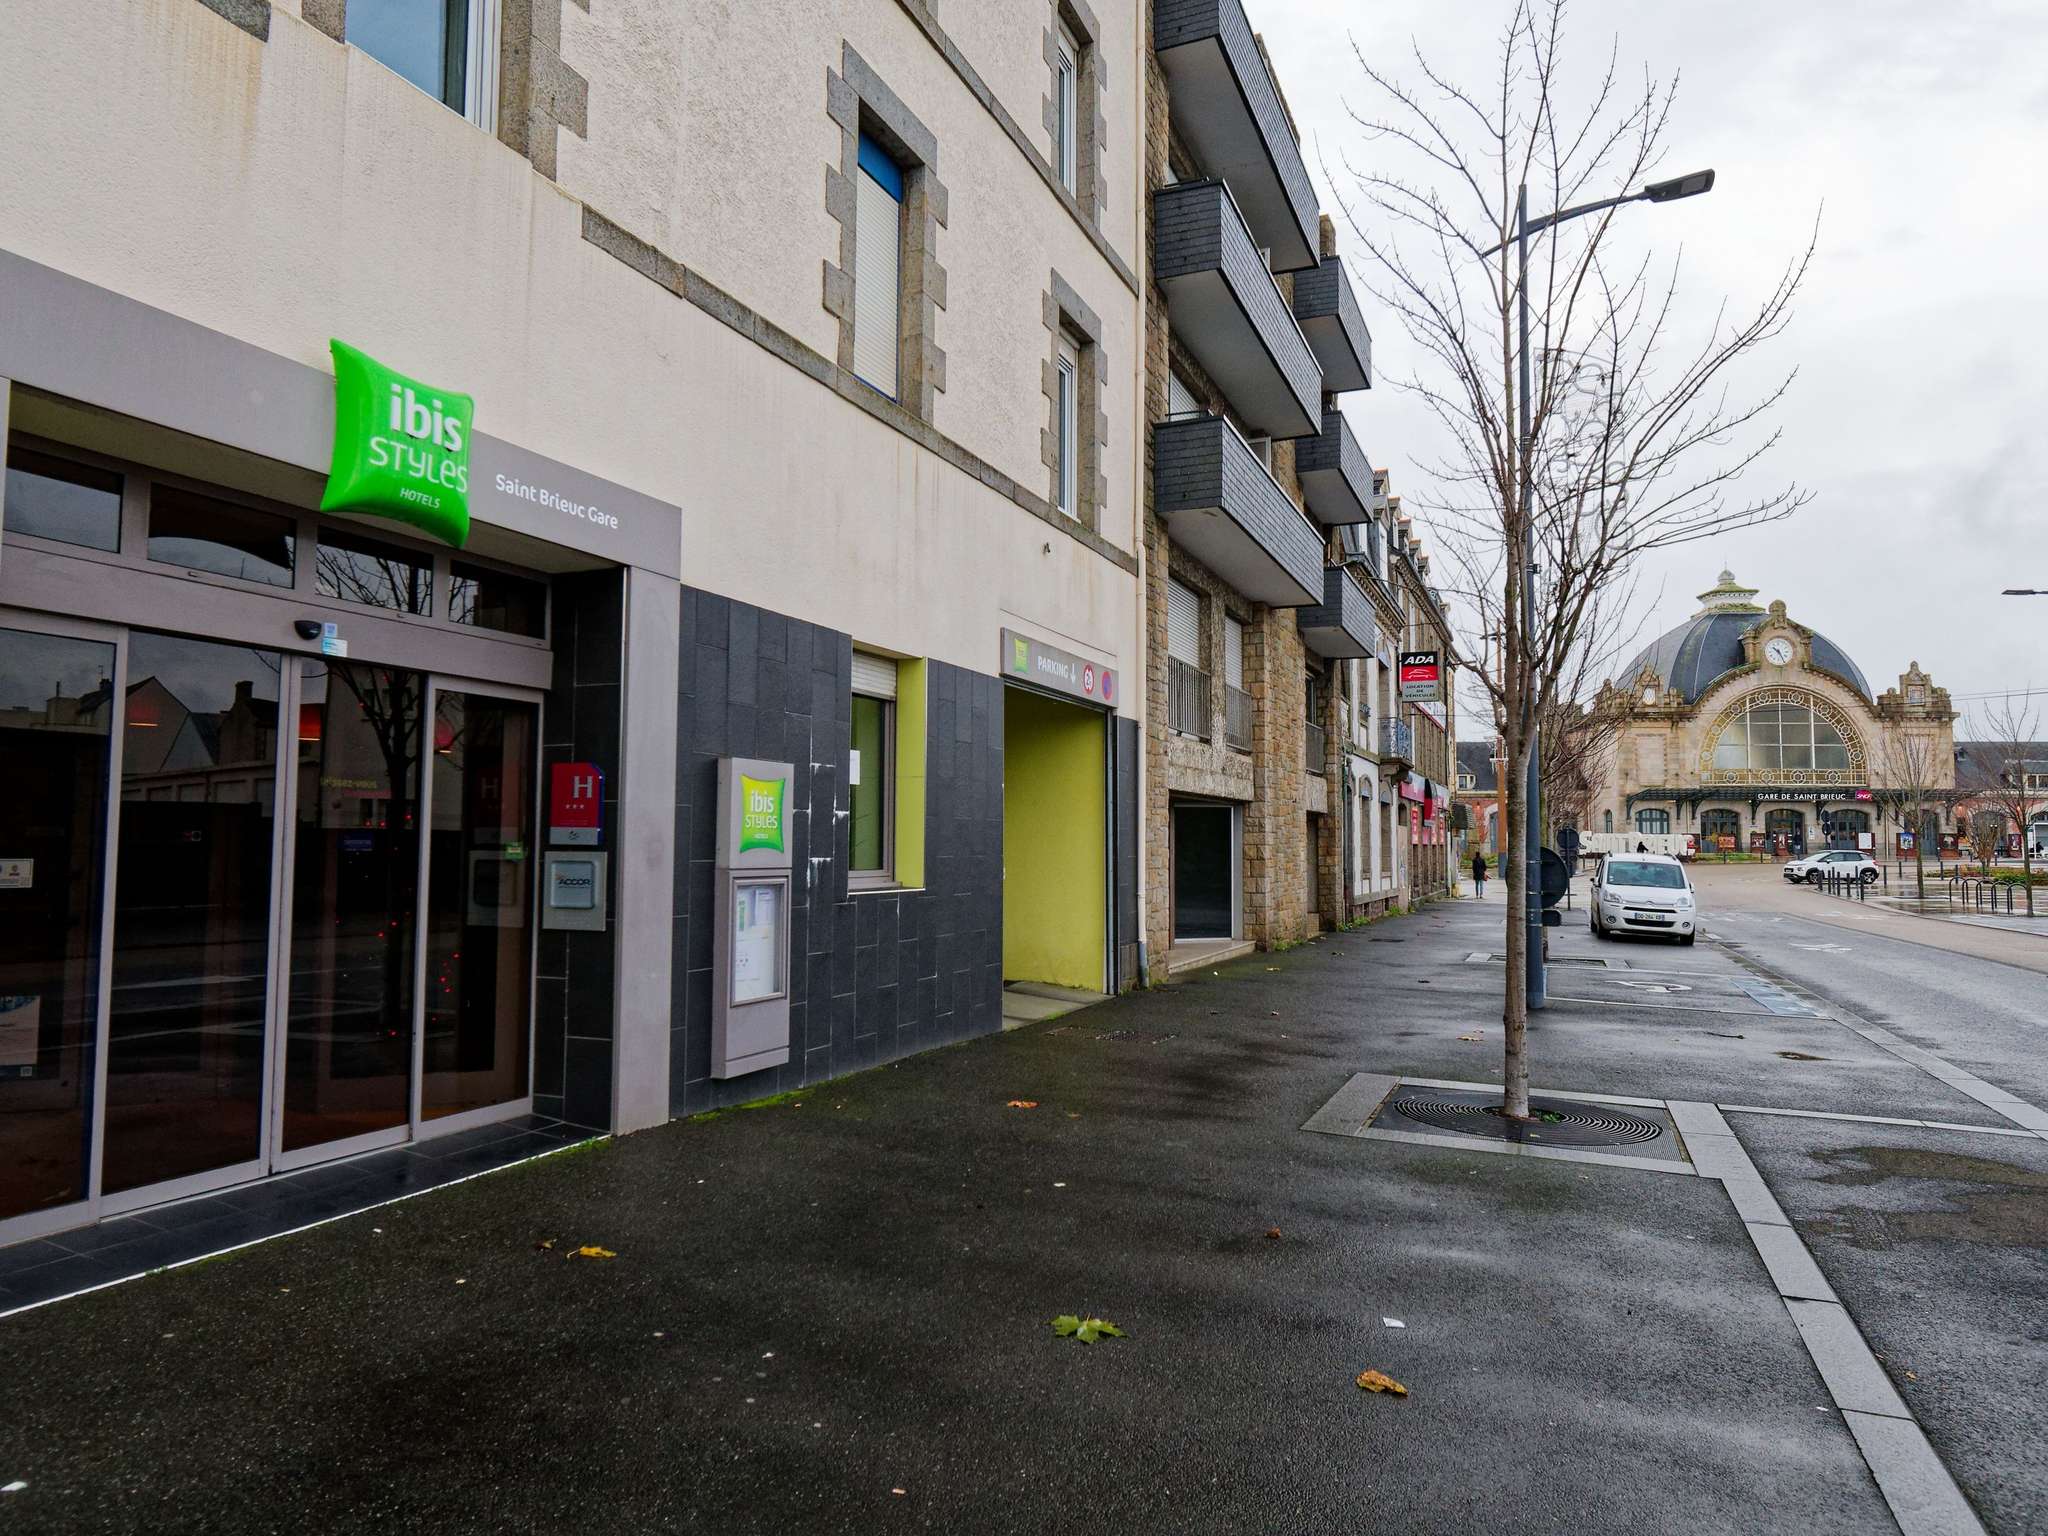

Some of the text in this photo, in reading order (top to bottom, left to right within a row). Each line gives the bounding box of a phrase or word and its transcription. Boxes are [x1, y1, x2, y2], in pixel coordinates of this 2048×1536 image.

[389, 383, 463, 452] ibis
[399, 487, 441, 509] HOTELS
[495, 473, 619, 530] Saint Brieuc Gare
[1037, 655, 1069, 679] PARKING
[1404, 655, 1434, 664] ADA
[572, 775, 593, 799] H
[751, 790, 774, 813] ibis
